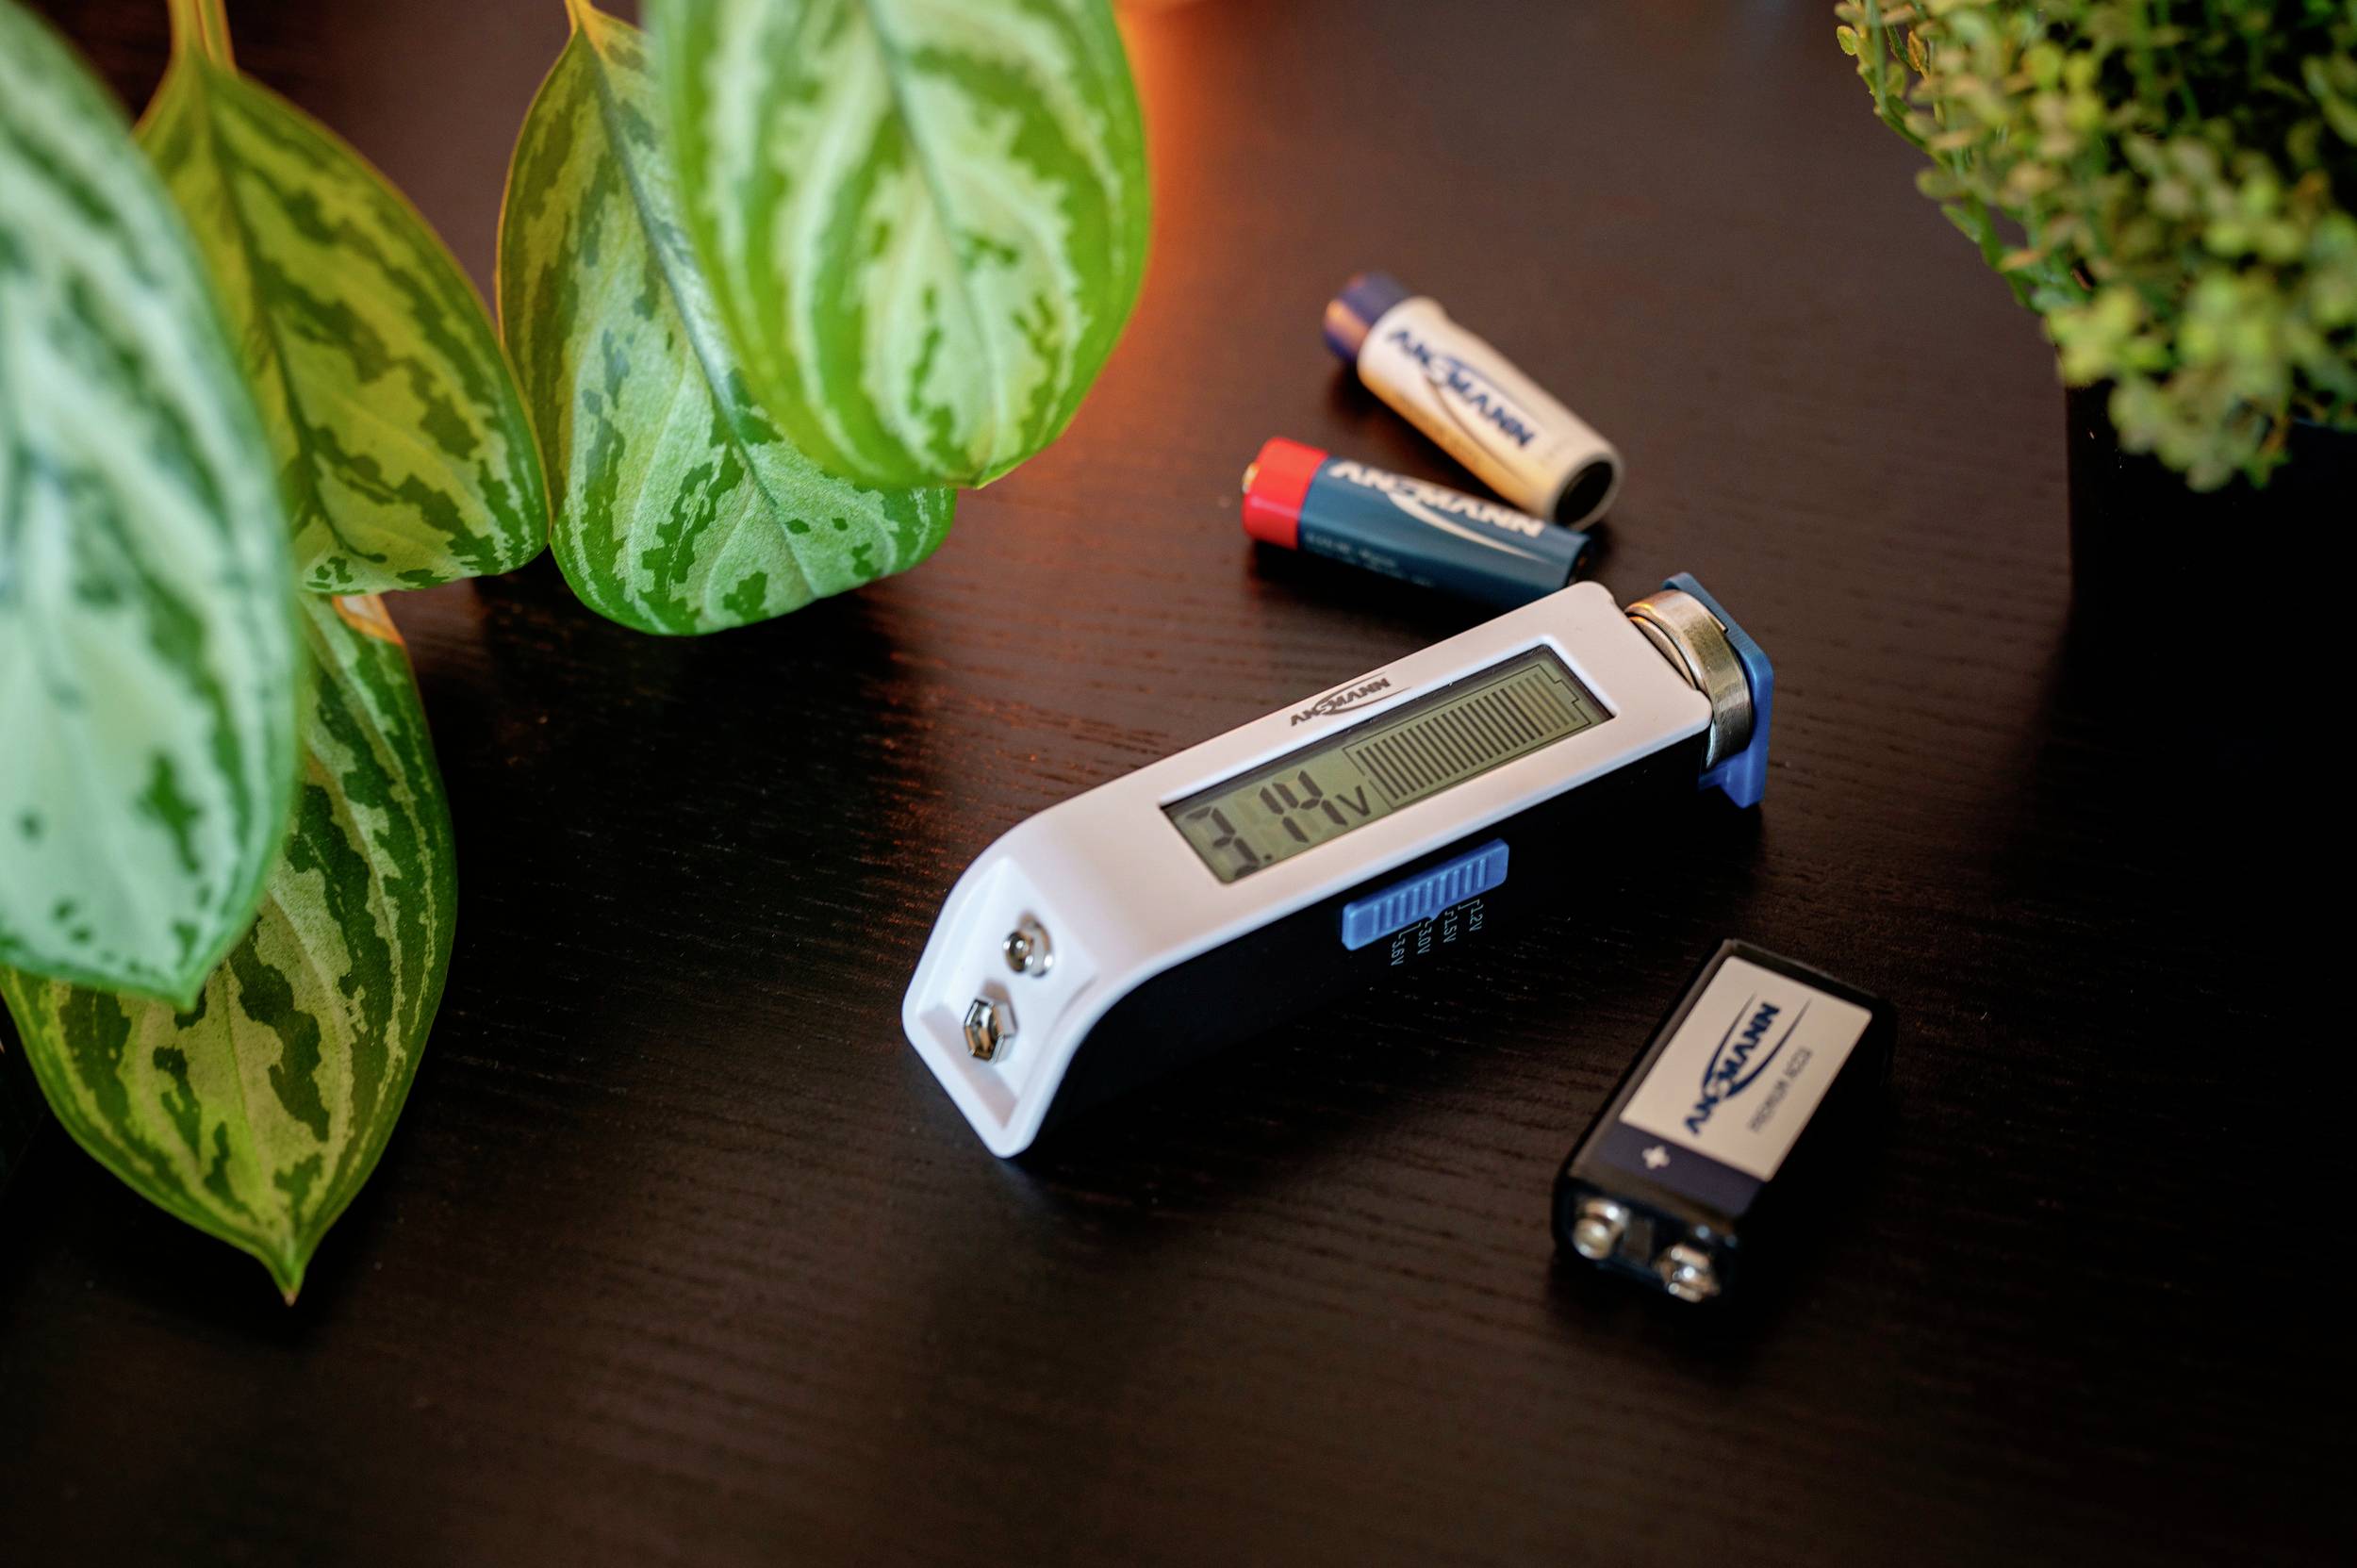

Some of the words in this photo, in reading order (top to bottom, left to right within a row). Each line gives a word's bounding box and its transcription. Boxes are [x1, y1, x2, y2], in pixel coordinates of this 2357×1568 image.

[1389, 330, 1535, 450] ANSMANN
[1327, 460, 1545, 538] ANSMANN
[1290, 677, 1392, 727] ANSMANN
[1442, 916, 1459, 943] 1.5V
[1469, 903, 1485, 932] 1.2V
[1390, 937, 1406, 966] 3.6V
[1417, 926, 1433, 954] 3.0V
[1685, 1000, 1781, 1135] ANSMANN
